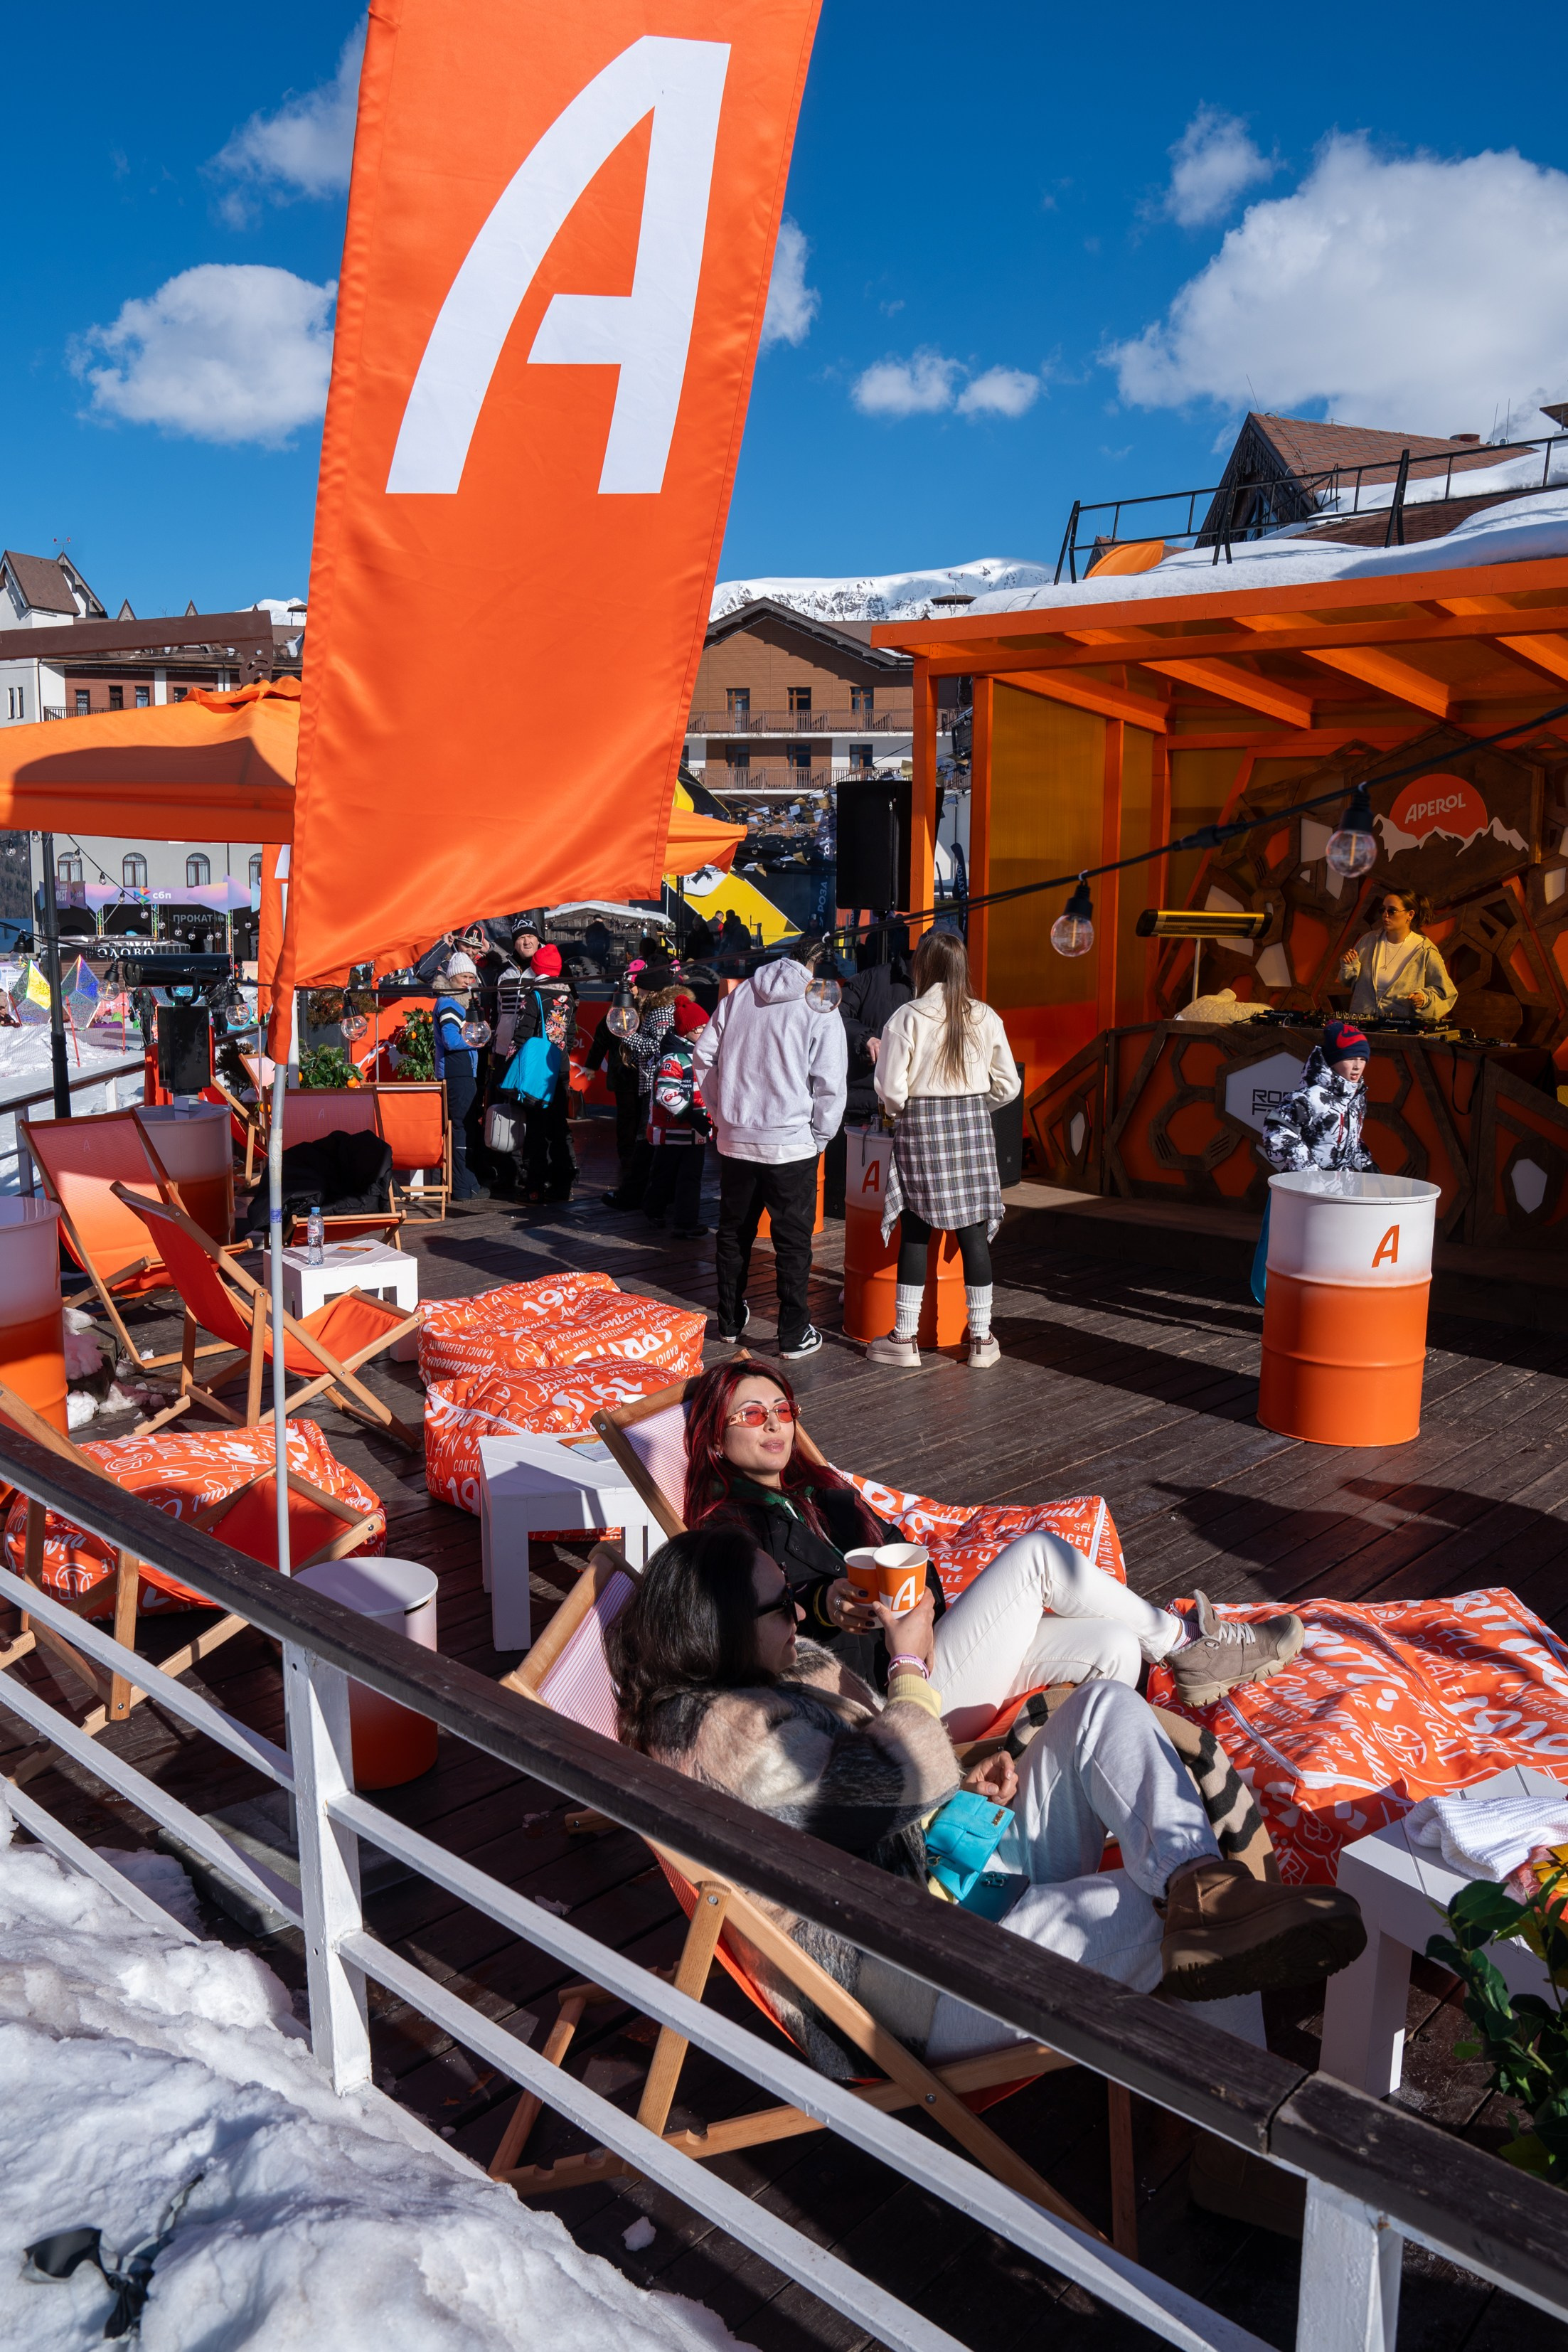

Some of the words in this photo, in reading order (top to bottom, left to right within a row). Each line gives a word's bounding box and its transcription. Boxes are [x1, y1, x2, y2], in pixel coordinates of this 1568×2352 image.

[385, 36, 731, 494] A
[1404, 793, 1466, 824] APEROL
[861, 1160, 880, 1193] A
[1371, 1224, 1399, 1268] A
[466, 1346, 495, 1359] RADICI
[526, 1368, 575, 1383] RITUAL
[939, 1550, 992, 1562] RITU
[892, 1575, 916, 1611] A
